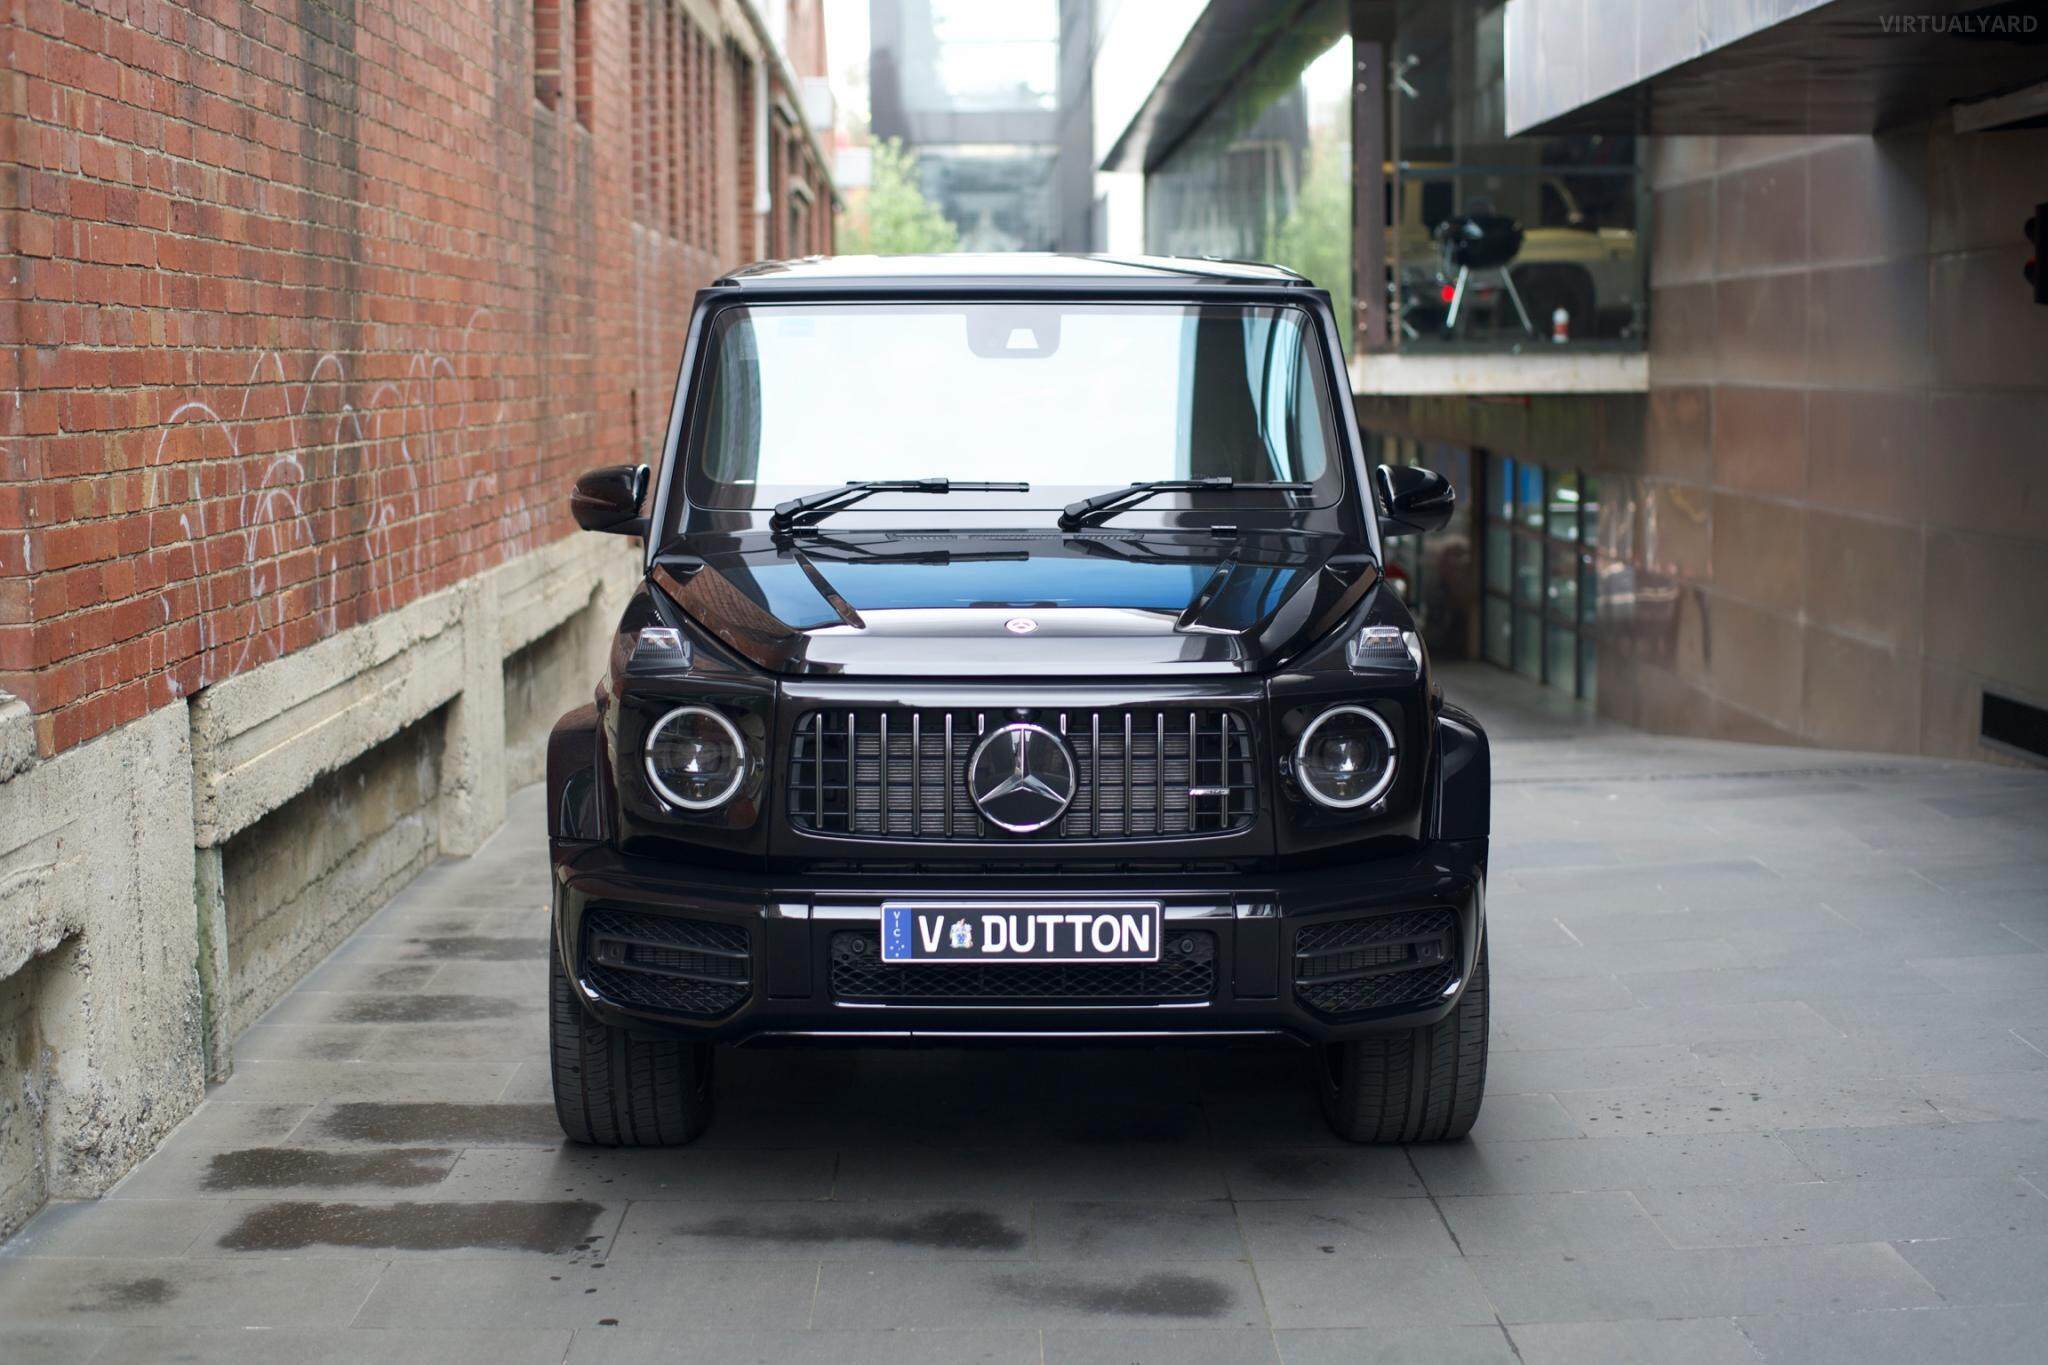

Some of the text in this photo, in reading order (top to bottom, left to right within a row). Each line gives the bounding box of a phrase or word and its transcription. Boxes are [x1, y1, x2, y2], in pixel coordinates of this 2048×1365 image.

[893, 911, 901, 937] VIC
[918, 914, 1150, 952] V DUTTON
